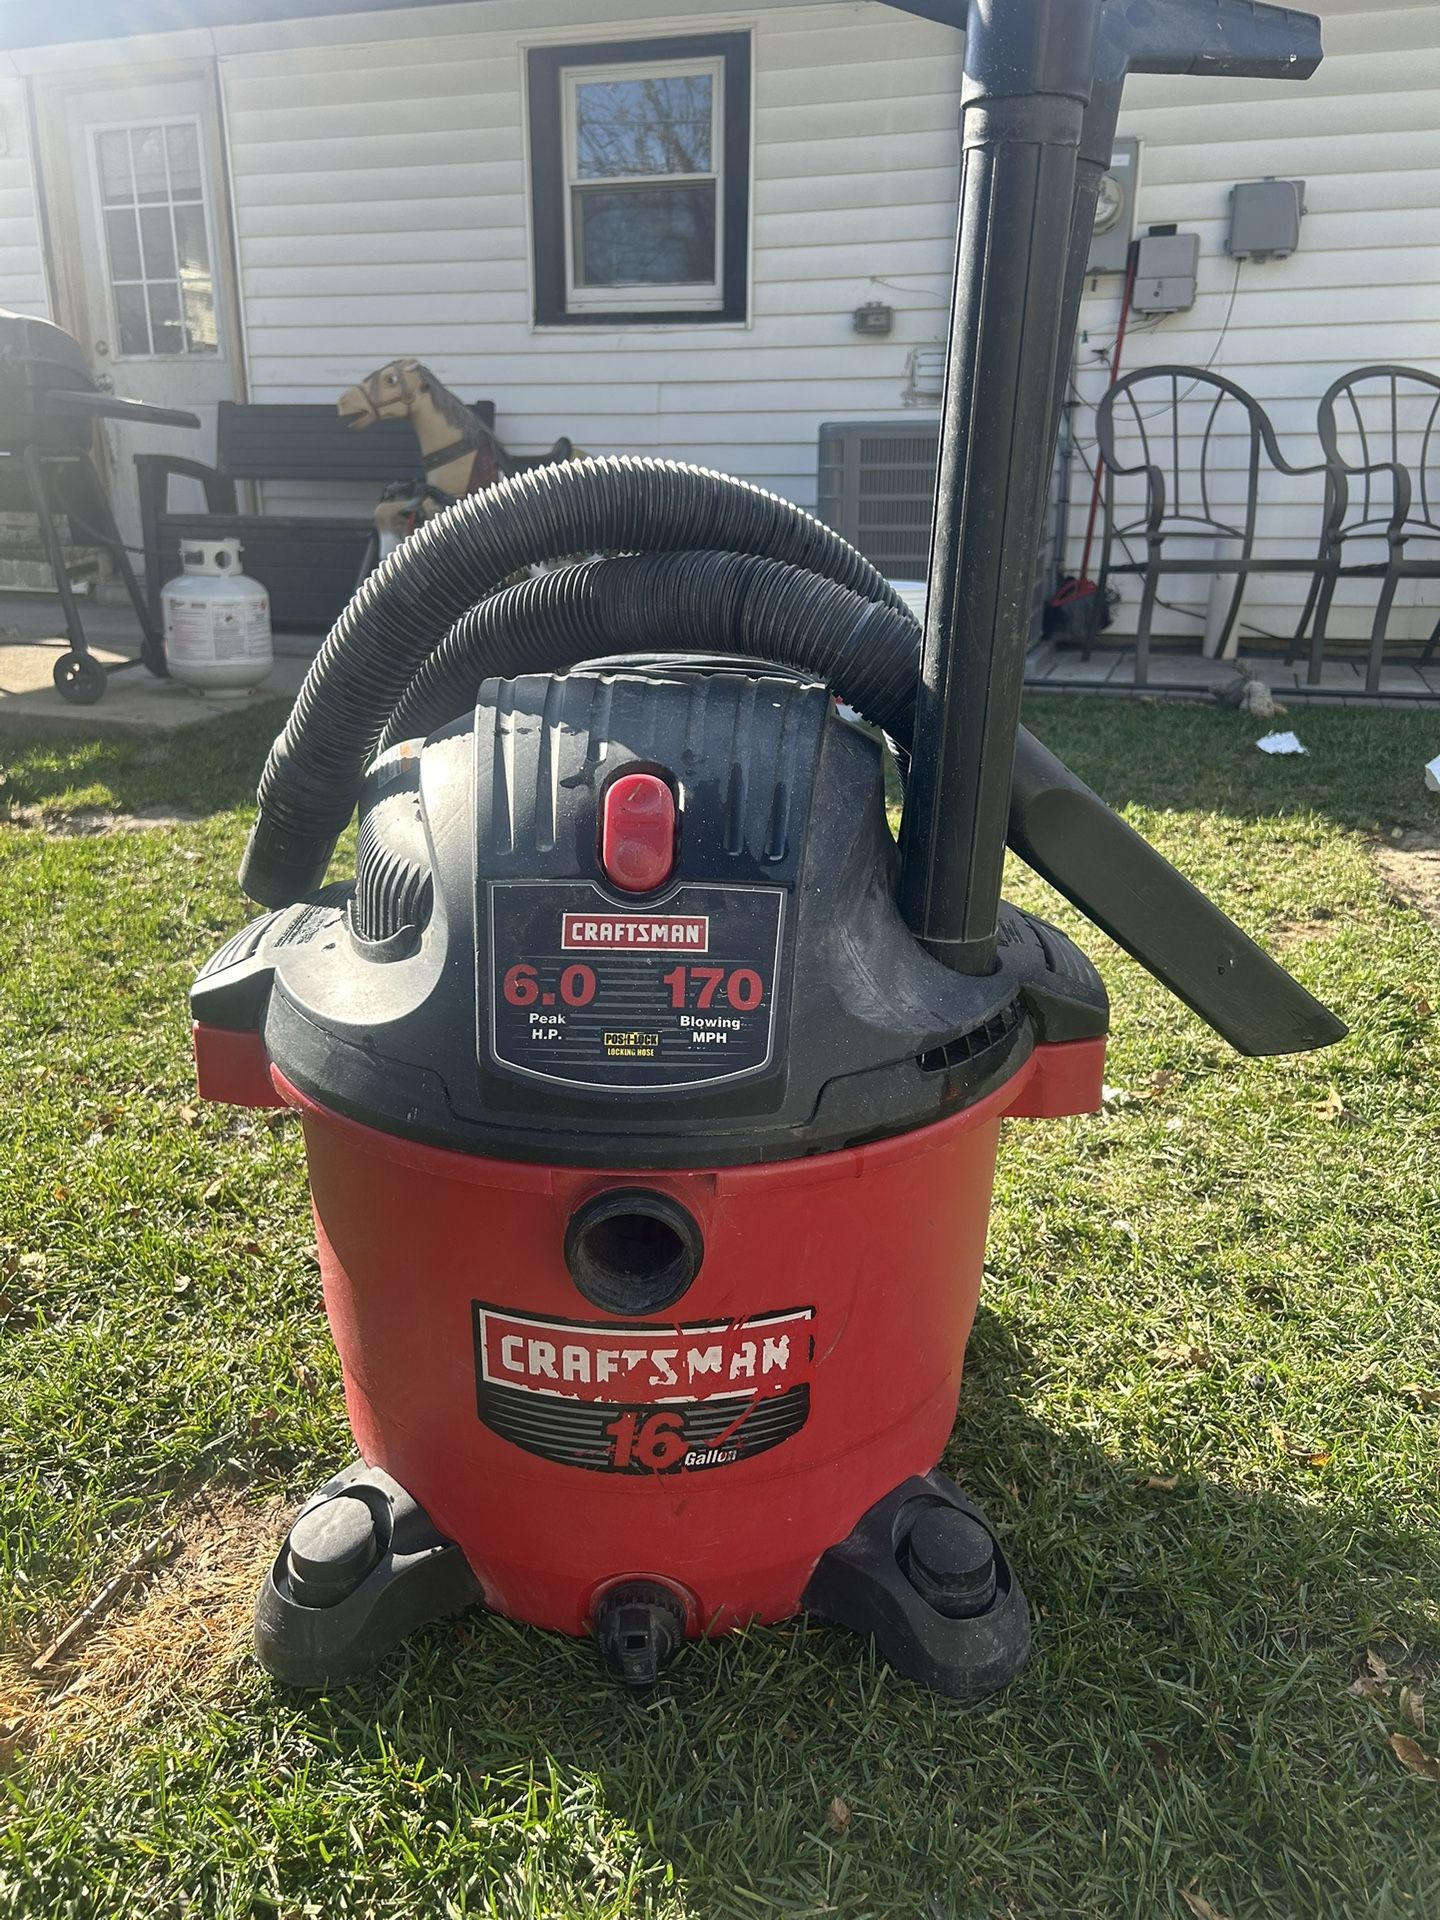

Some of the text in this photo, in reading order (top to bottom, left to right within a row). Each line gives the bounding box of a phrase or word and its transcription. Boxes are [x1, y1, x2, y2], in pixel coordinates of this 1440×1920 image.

[571, 921, 700, 944] CRAFTSMAN
[503, 963, 597, 1007] 6.0
[663, 965, 764, 1011] 170
[529, 1012, 566, 1025] Peak
[680, 1015, 741, 1031] Blowing
[532, 1028, 562, 1040] H.P.
[692, 1031, 727, 1044] MPH
[607, 1048, 655, 1057] LOCKING HOSE
[607, 1411, 737, 1469] 16 Gallon
